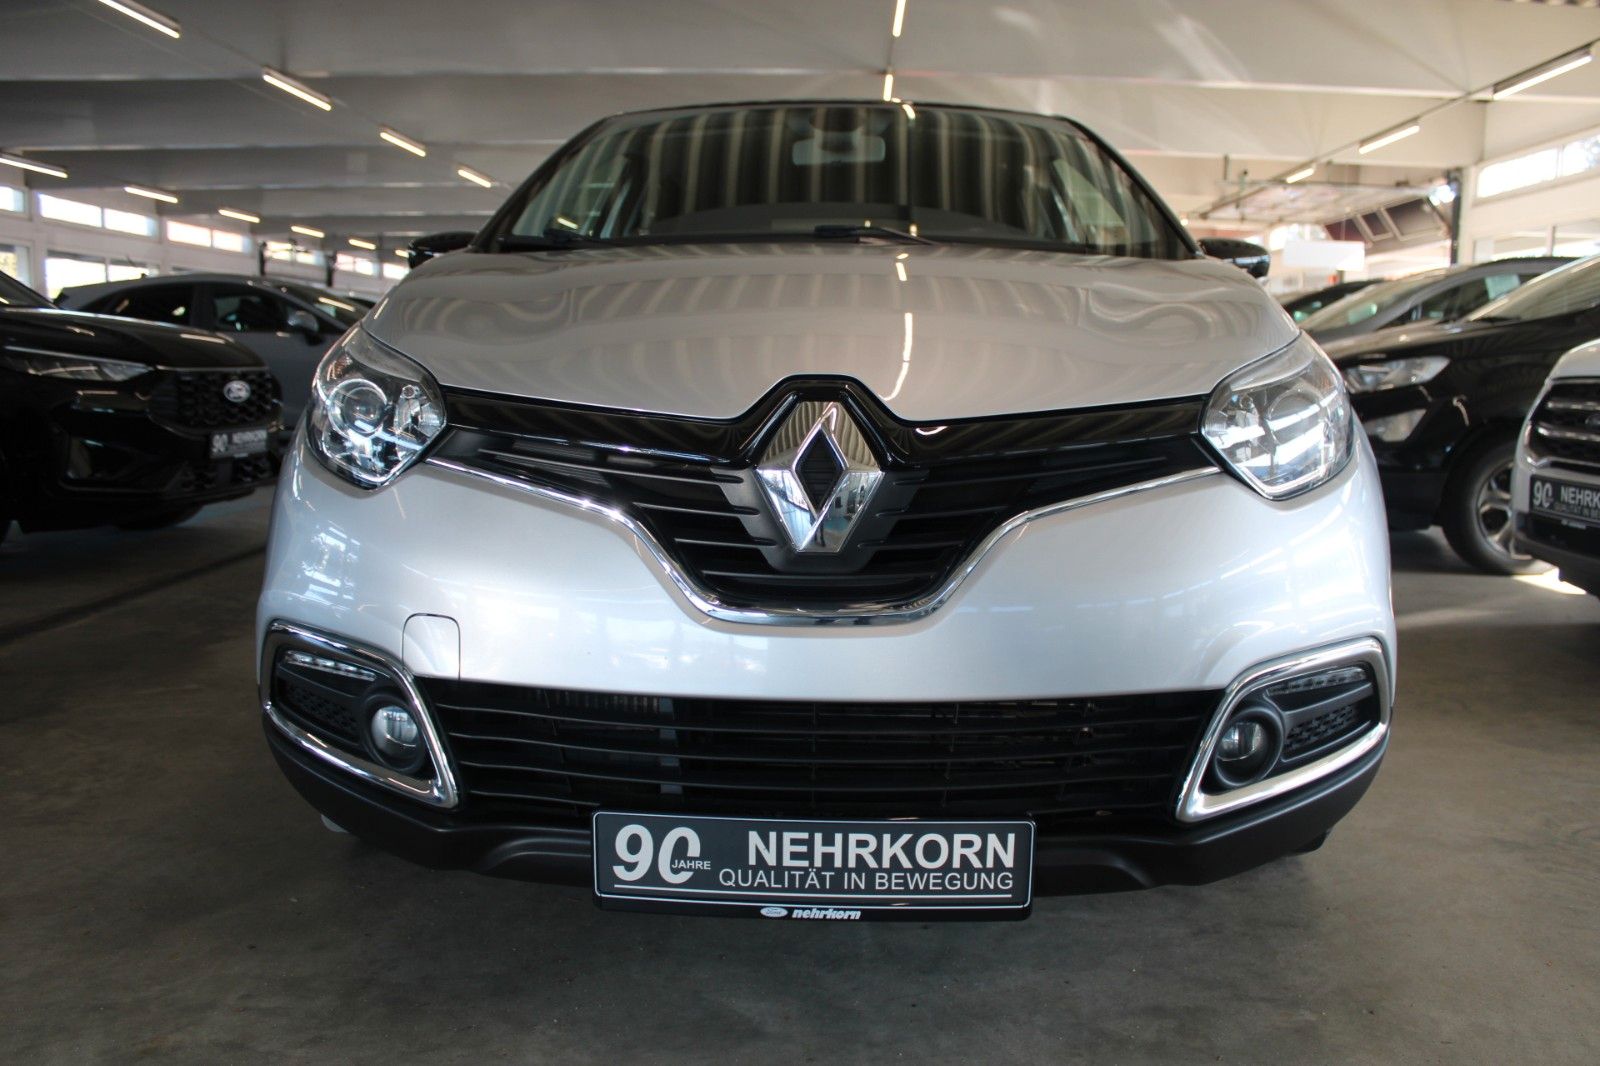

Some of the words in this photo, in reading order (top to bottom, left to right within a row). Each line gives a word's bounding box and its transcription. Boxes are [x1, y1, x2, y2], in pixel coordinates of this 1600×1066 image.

[1533, 481, 1552, 508] 90
[613, 824, 700, 884] 90
[748, 831, 1015, 869] NEHRKORN
[671, 860, 712, 870] JAHRE
[719, 868, 835, 889] QUALITÄT
[844, 872, 866, 889] IN
[875, 872, 1013, 890] BEWEGUNG
[792, 908, 861, 919] nehrkorn
